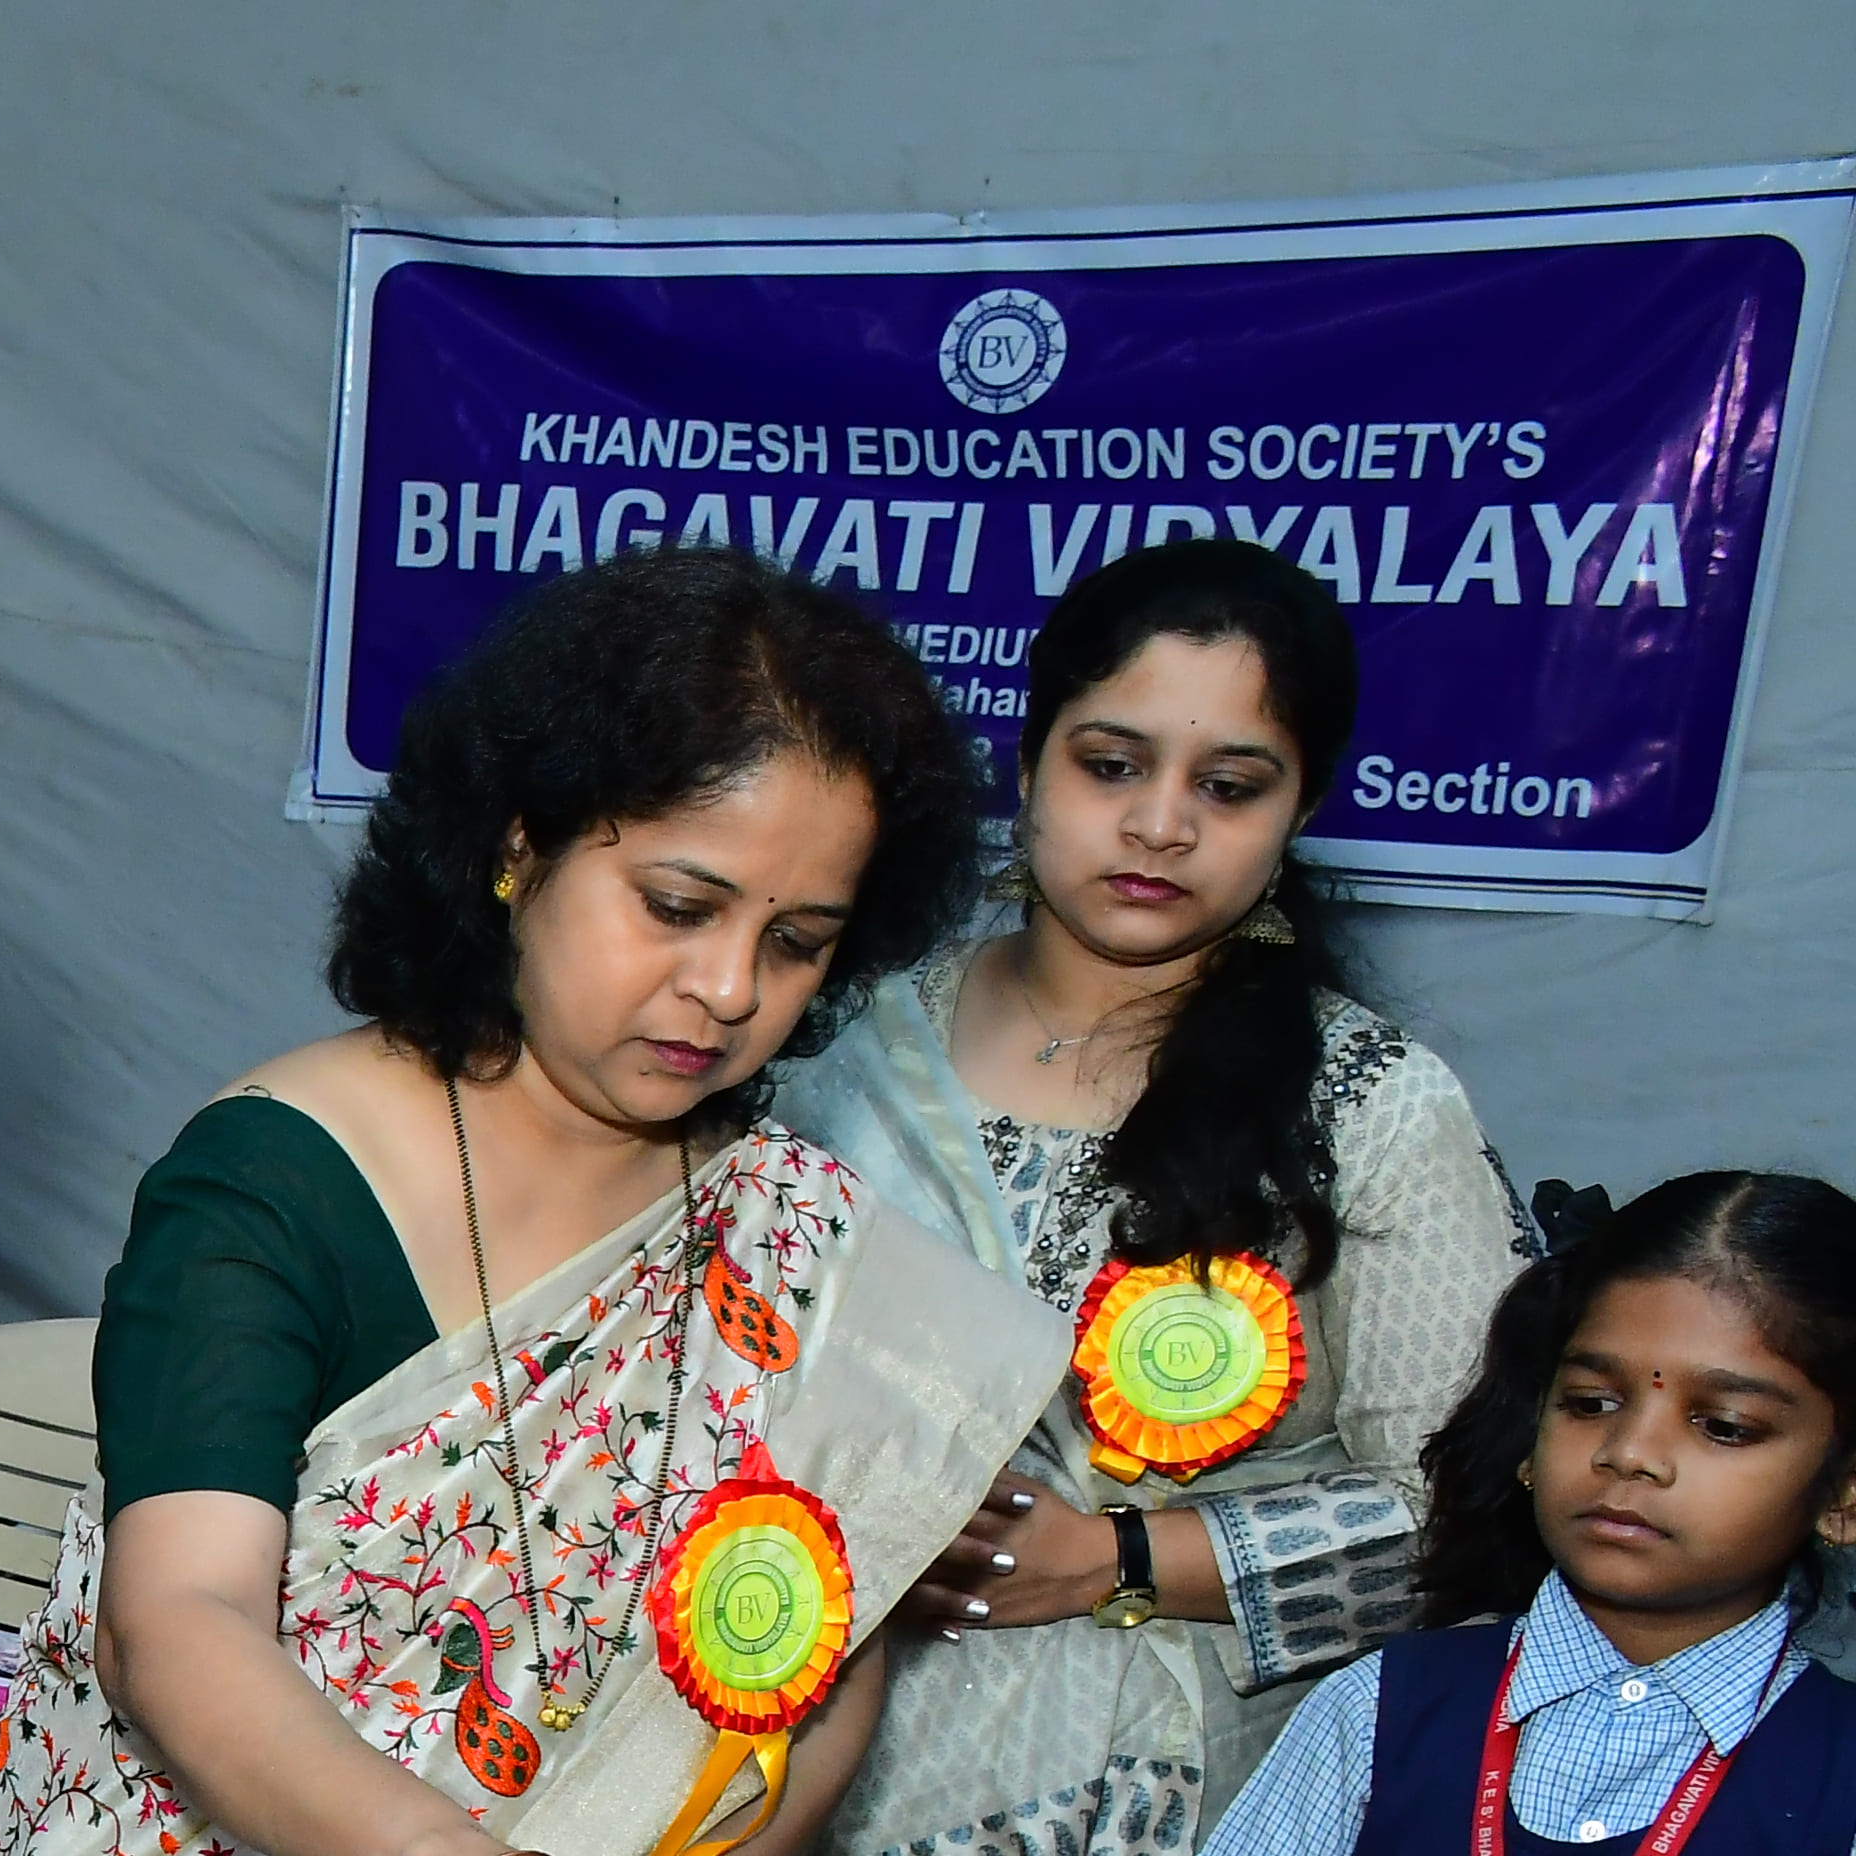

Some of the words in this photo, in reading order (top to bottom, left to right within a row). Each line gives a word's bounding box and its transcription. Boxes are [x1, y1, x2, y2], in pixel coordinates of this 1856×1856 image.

[978, 335, 1028, 369] BV
[519, 412, 828, 475] KHANDESH
[847, 426, 1186, 479] EDUCATION
[1207, 420, 1547, 480] SOCIETY'S
[1352, 754, 1592, 818] Section
[1168, 1340, 1206, 1367] BV
[736, 1592, 771, 1625] BV
[1651, 1772, 1710, 1854] BHAGAVATI
